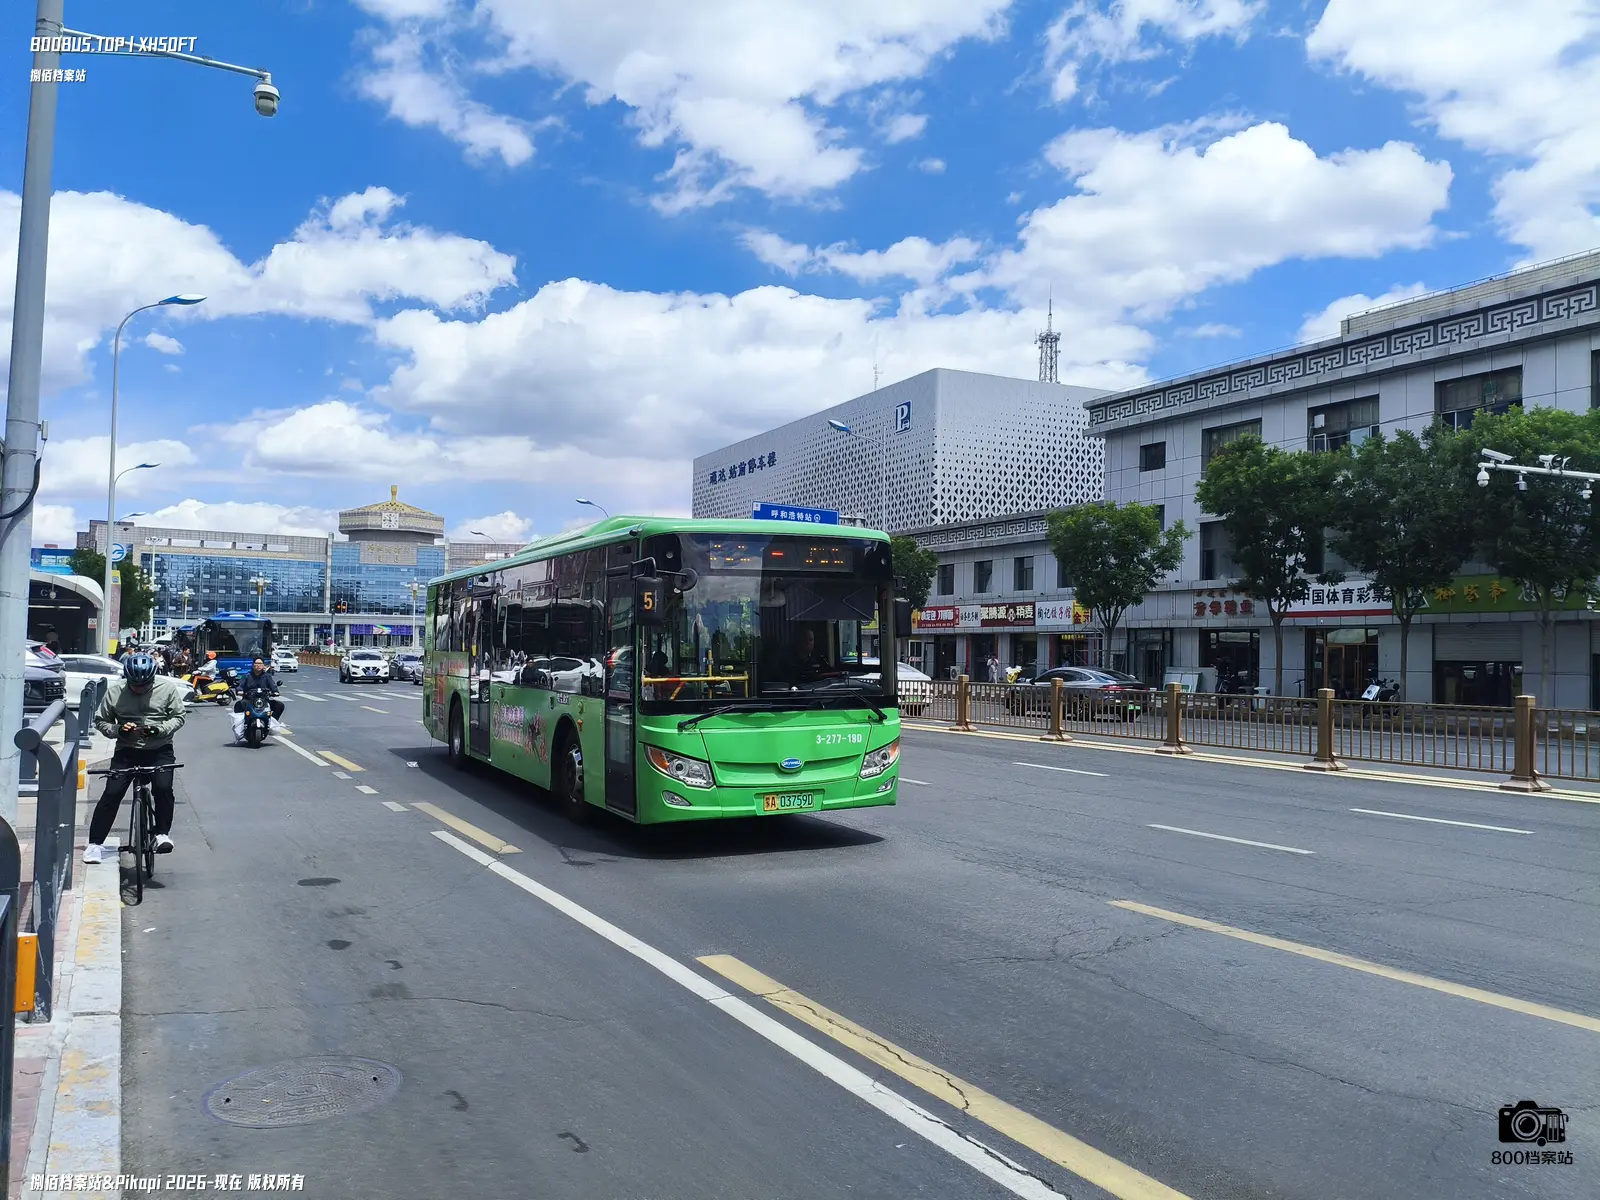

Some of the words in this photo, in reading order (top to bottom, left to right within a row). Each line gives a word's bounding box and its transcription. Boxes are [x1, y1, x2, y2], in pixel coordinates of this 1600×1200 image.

[898, 404, 909, 431] P
[770, 509, 812, 522] 呼和浩特站
[644, 591, 653, 610] 5
